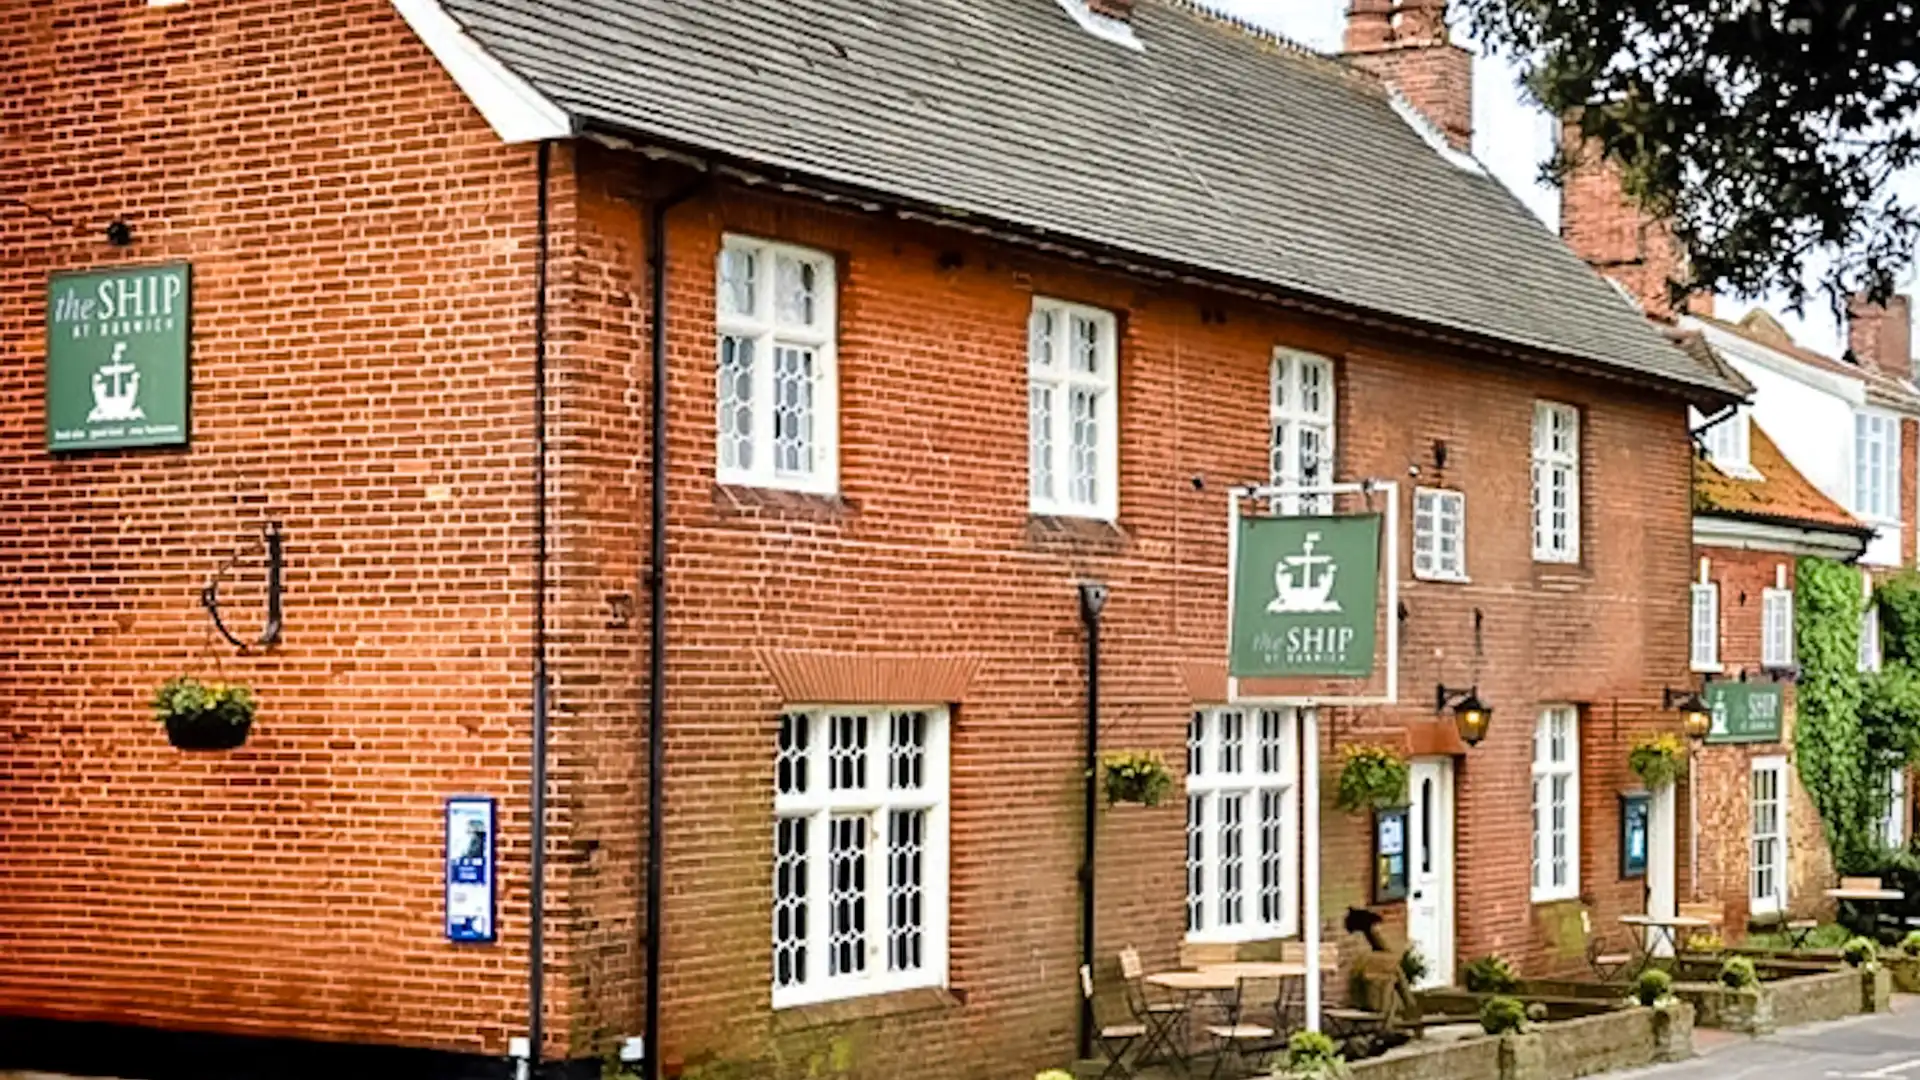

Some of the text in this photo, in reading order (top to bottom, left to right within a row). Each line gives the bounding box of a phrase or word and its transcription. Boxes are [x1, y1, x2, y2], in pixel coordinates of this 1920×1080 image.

[55, 274, 181, 322] the SHIP
[1286, 626, 1353, 653] SHIP
